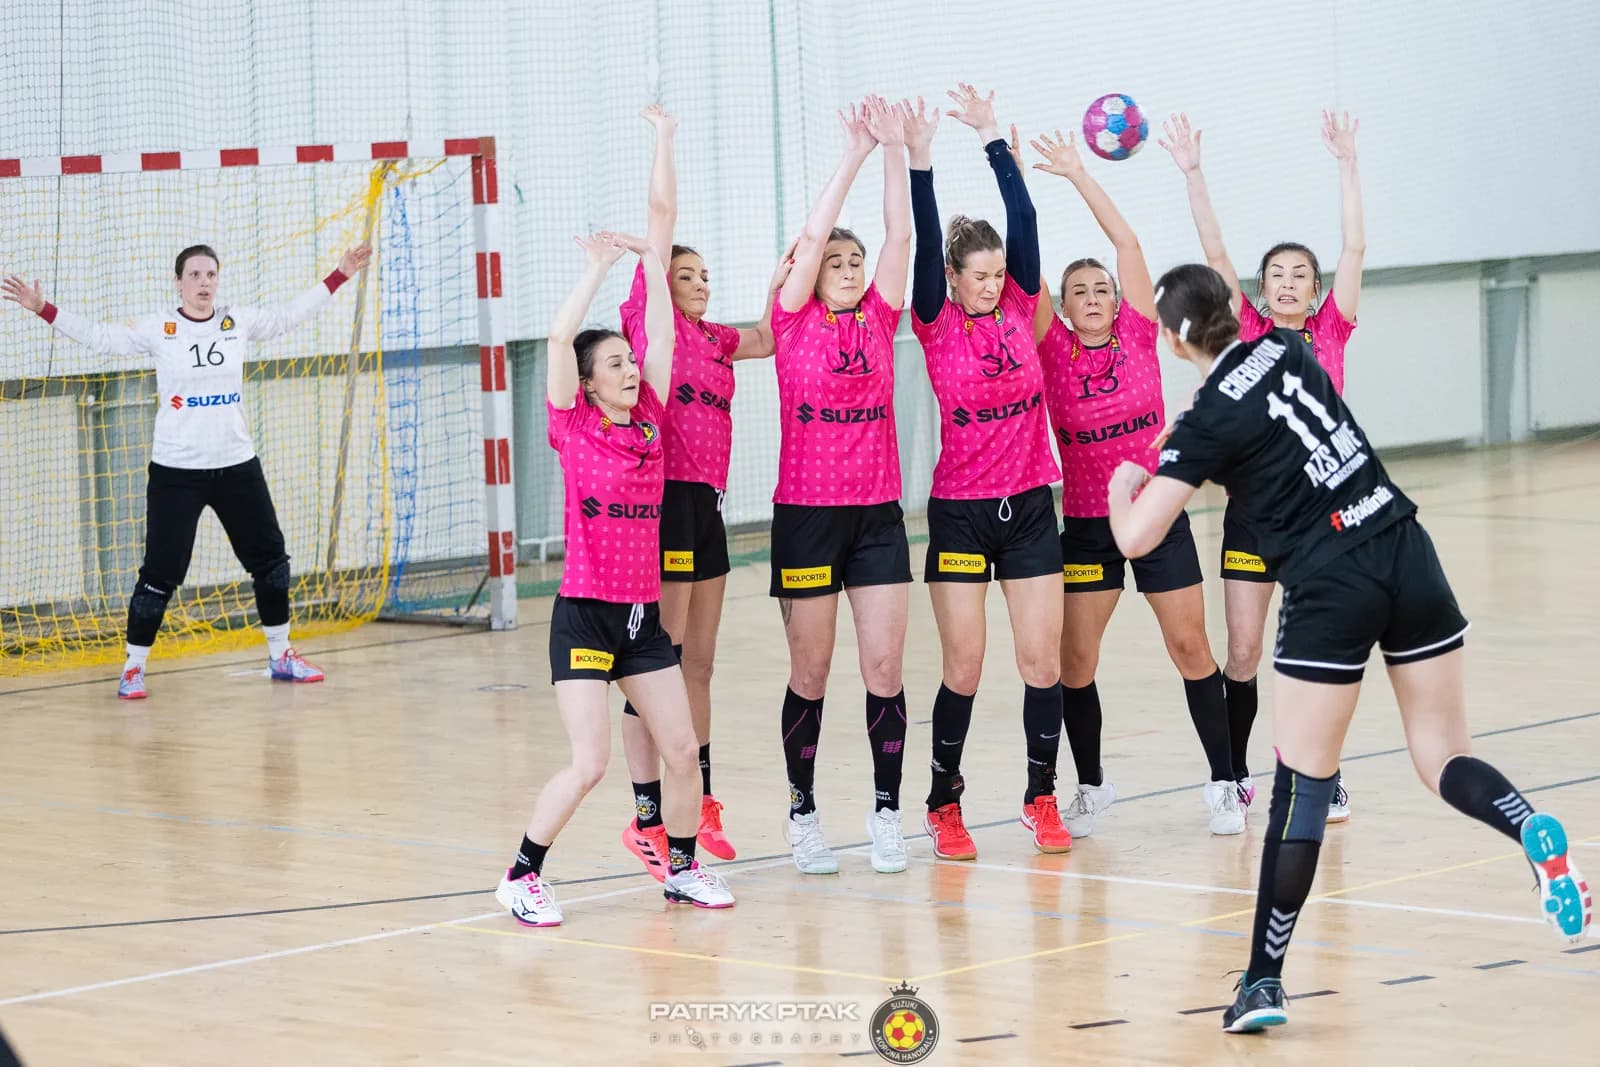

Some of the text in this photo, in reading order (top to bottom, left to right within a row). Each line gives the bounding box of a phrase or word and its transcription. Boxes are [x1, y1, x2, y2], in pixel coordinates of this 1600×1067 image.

[188, 341, 225, 368] 16
[981, 342, 1022, 378] 31
[1075, 410, 1159, 444] SUZUKI
[1266, 370, 1338, 452] 11
[1303, 444, 1341, 488] AZS
[789, 572, 827, 582] KOLPORTER
[947, 558, 982, 567] KOLPORTER
